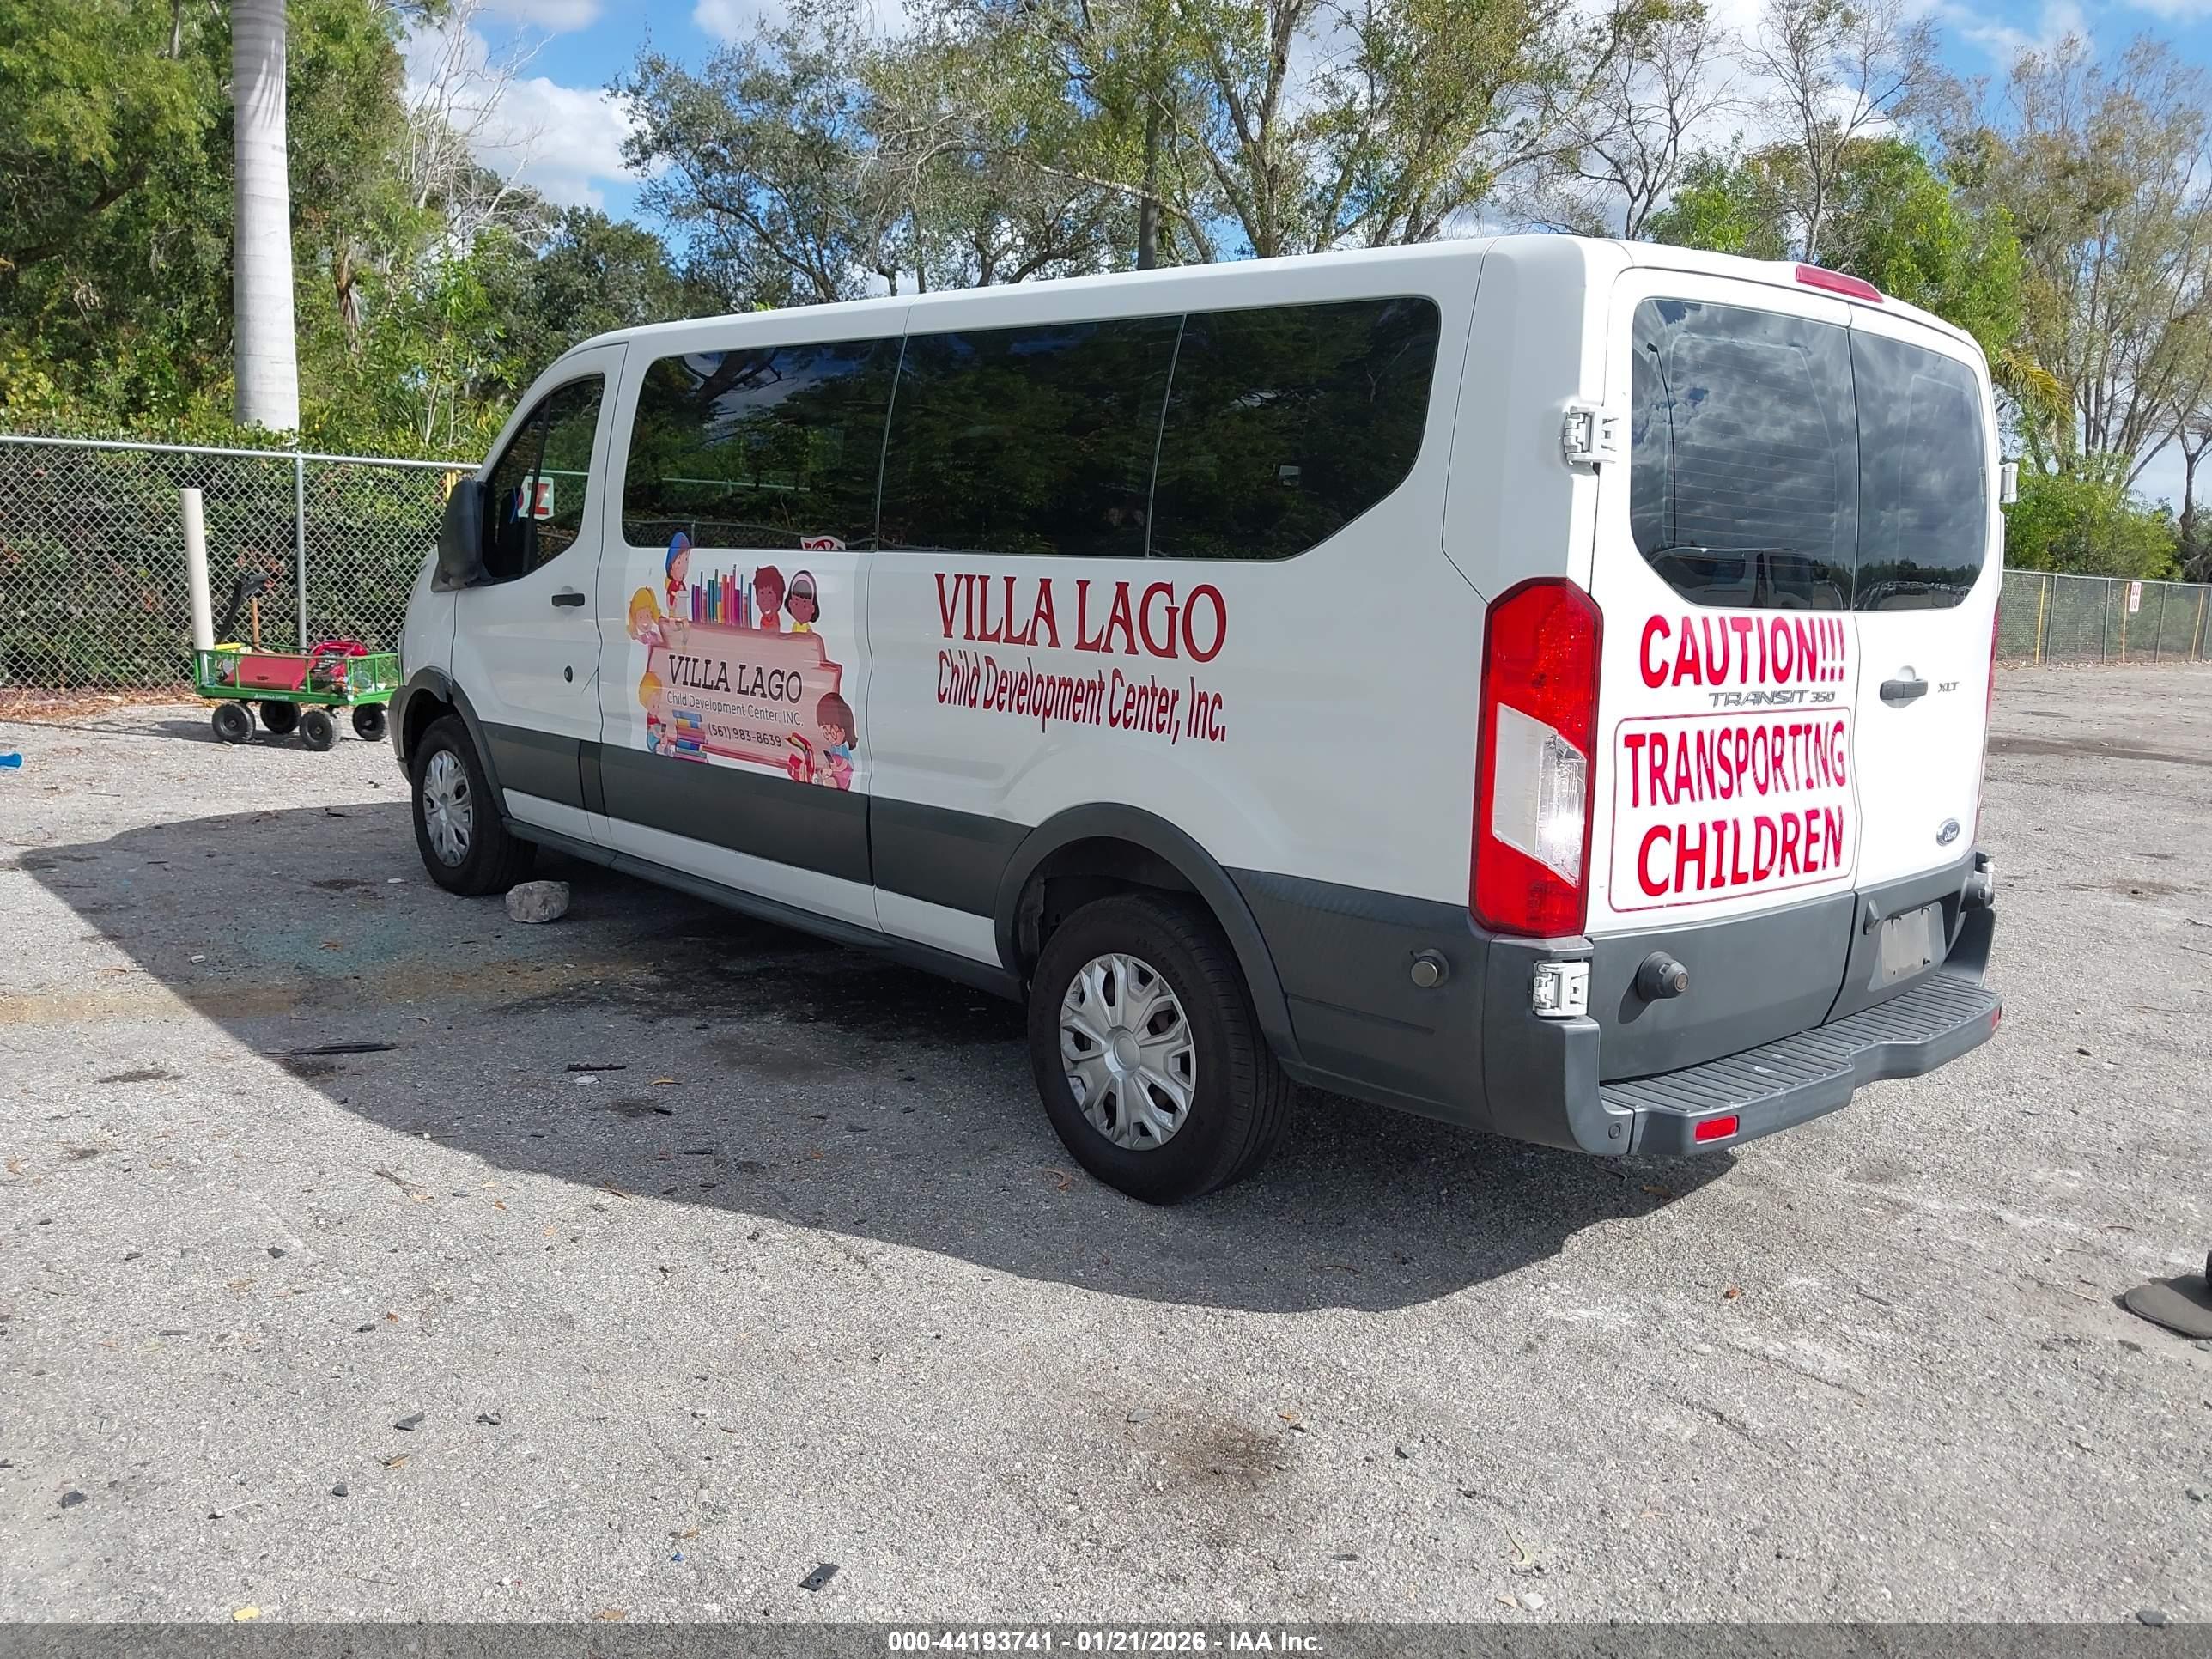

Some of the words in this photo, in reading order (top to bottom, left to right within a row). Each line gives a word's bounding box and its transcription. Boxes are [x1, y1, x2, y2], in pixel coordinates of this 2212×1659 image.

[934, 573, 1061, 649] VILLA
[1074, 580, 1227, 663] LAGO
[668, 654, 731, 693] VILLA
[737, 664, 803, 704] LAGO
[1639, 614, 1845, 689] CAUTION!!!
[666, 690, 688, 707] Child
[689, 696, 746, 718] Development
[747, 704, 781, 724] Center,
[782, 711, 805, 727] INC.
[937, 648, 981, 708] Child
[982, 657, 1105, 734] Development
[1108, 667, 1180, 745] Center,
[1187, 676, 1226, 743] Inc.
[1708, 690, 1809, 708] TRANSIT
[1809, 690, 1836, 704] 350
[1937, 681, 1960, 693] XLT
[708, 722, 732, 740] (561)
[733, 727, 782, 748] 983-8639
[1624, 720, 1847, 808] TRANSPORTING
[1638, 805, 1845, 897] CHILDREN
